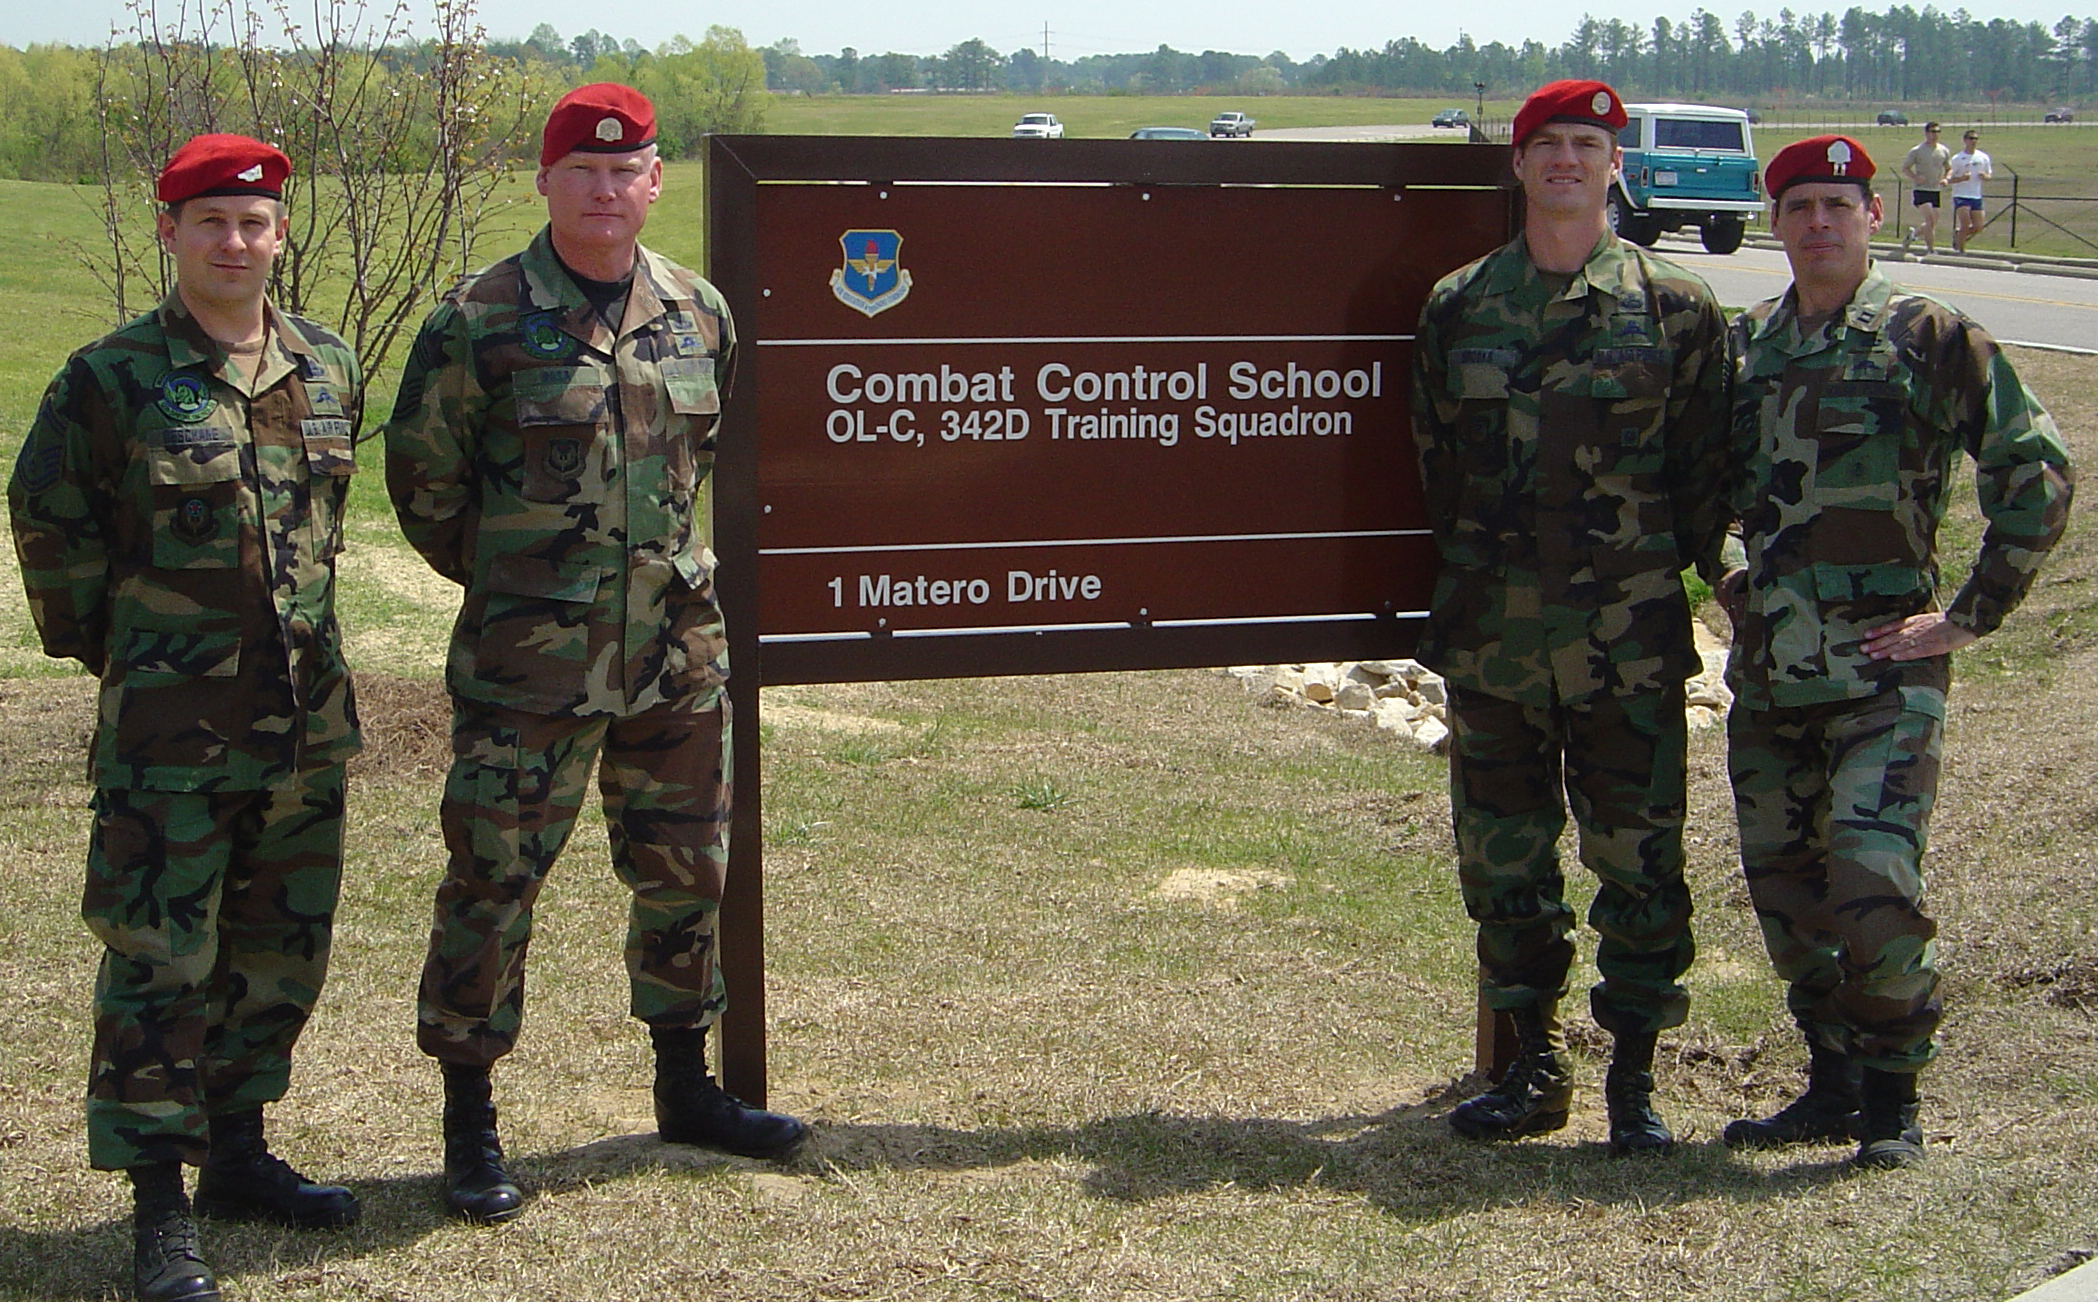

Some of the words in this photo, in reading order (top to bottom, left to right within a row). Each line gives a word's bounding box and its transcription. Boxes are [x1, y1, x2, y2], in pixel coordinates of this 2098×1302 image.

[826, 363, 1015, 404] Combat
[1037, 362, 1207, 402] Control
[1228, 361, 1381, 400] School
[826, 408, 925, 448] OL-C,
[940, 408, 1030, 442] 342D
[1044, 407, 1179, 447] Training
[1194, 404, 1352, 445] Squadron
[827, 576, 842, 608] 1
[859, 575, 990, 607] Matero
[1007, 569, 1102, 602] Drive
